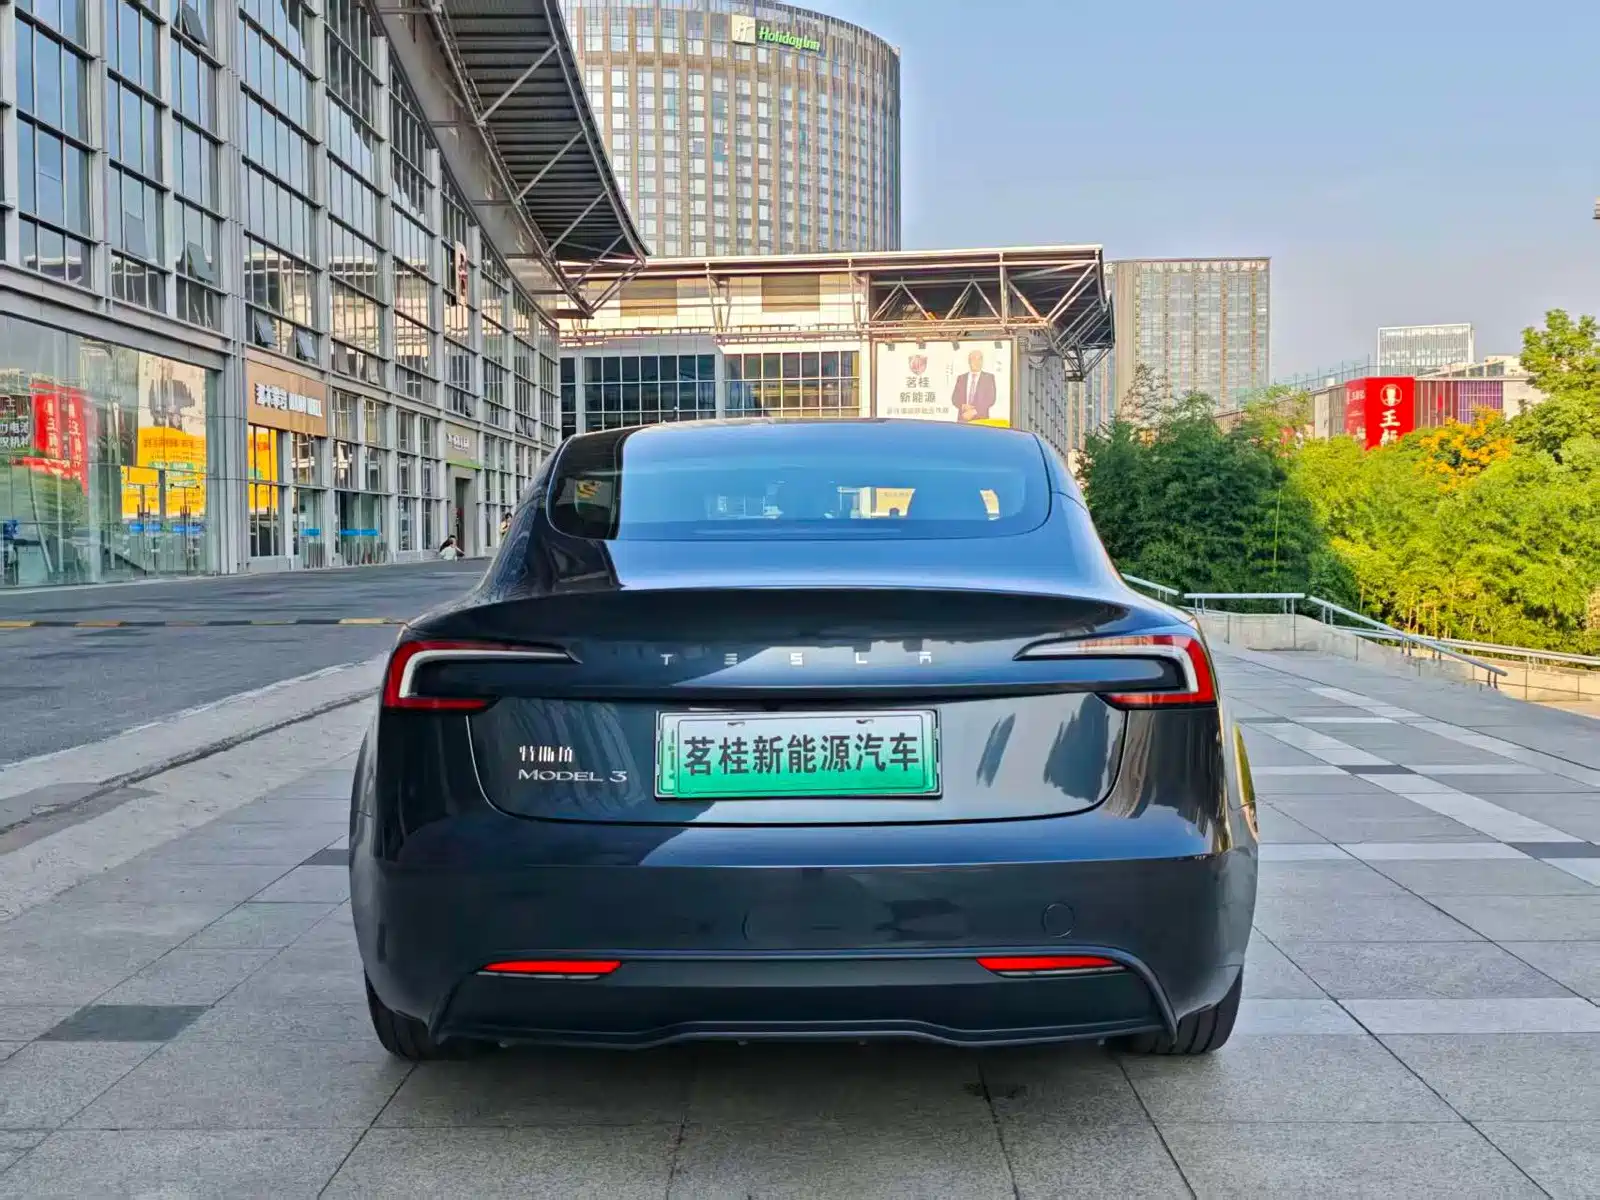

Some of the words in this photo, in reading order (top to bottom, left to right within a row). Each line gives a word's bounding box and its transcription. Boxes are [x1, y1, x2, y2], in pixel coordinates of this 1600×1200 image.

[759, 26, 802, 49] Holiday
[905, 376, 931, 388] 茗桂
[900, 391, 936, 404] 新能源
[661, 652, 932, 665] TESLA
[684, 732, 919, 776] 茗桂新能源汽车
[518, 769, 604, 782] MODEL
[609, 770, 628, 782] 3
